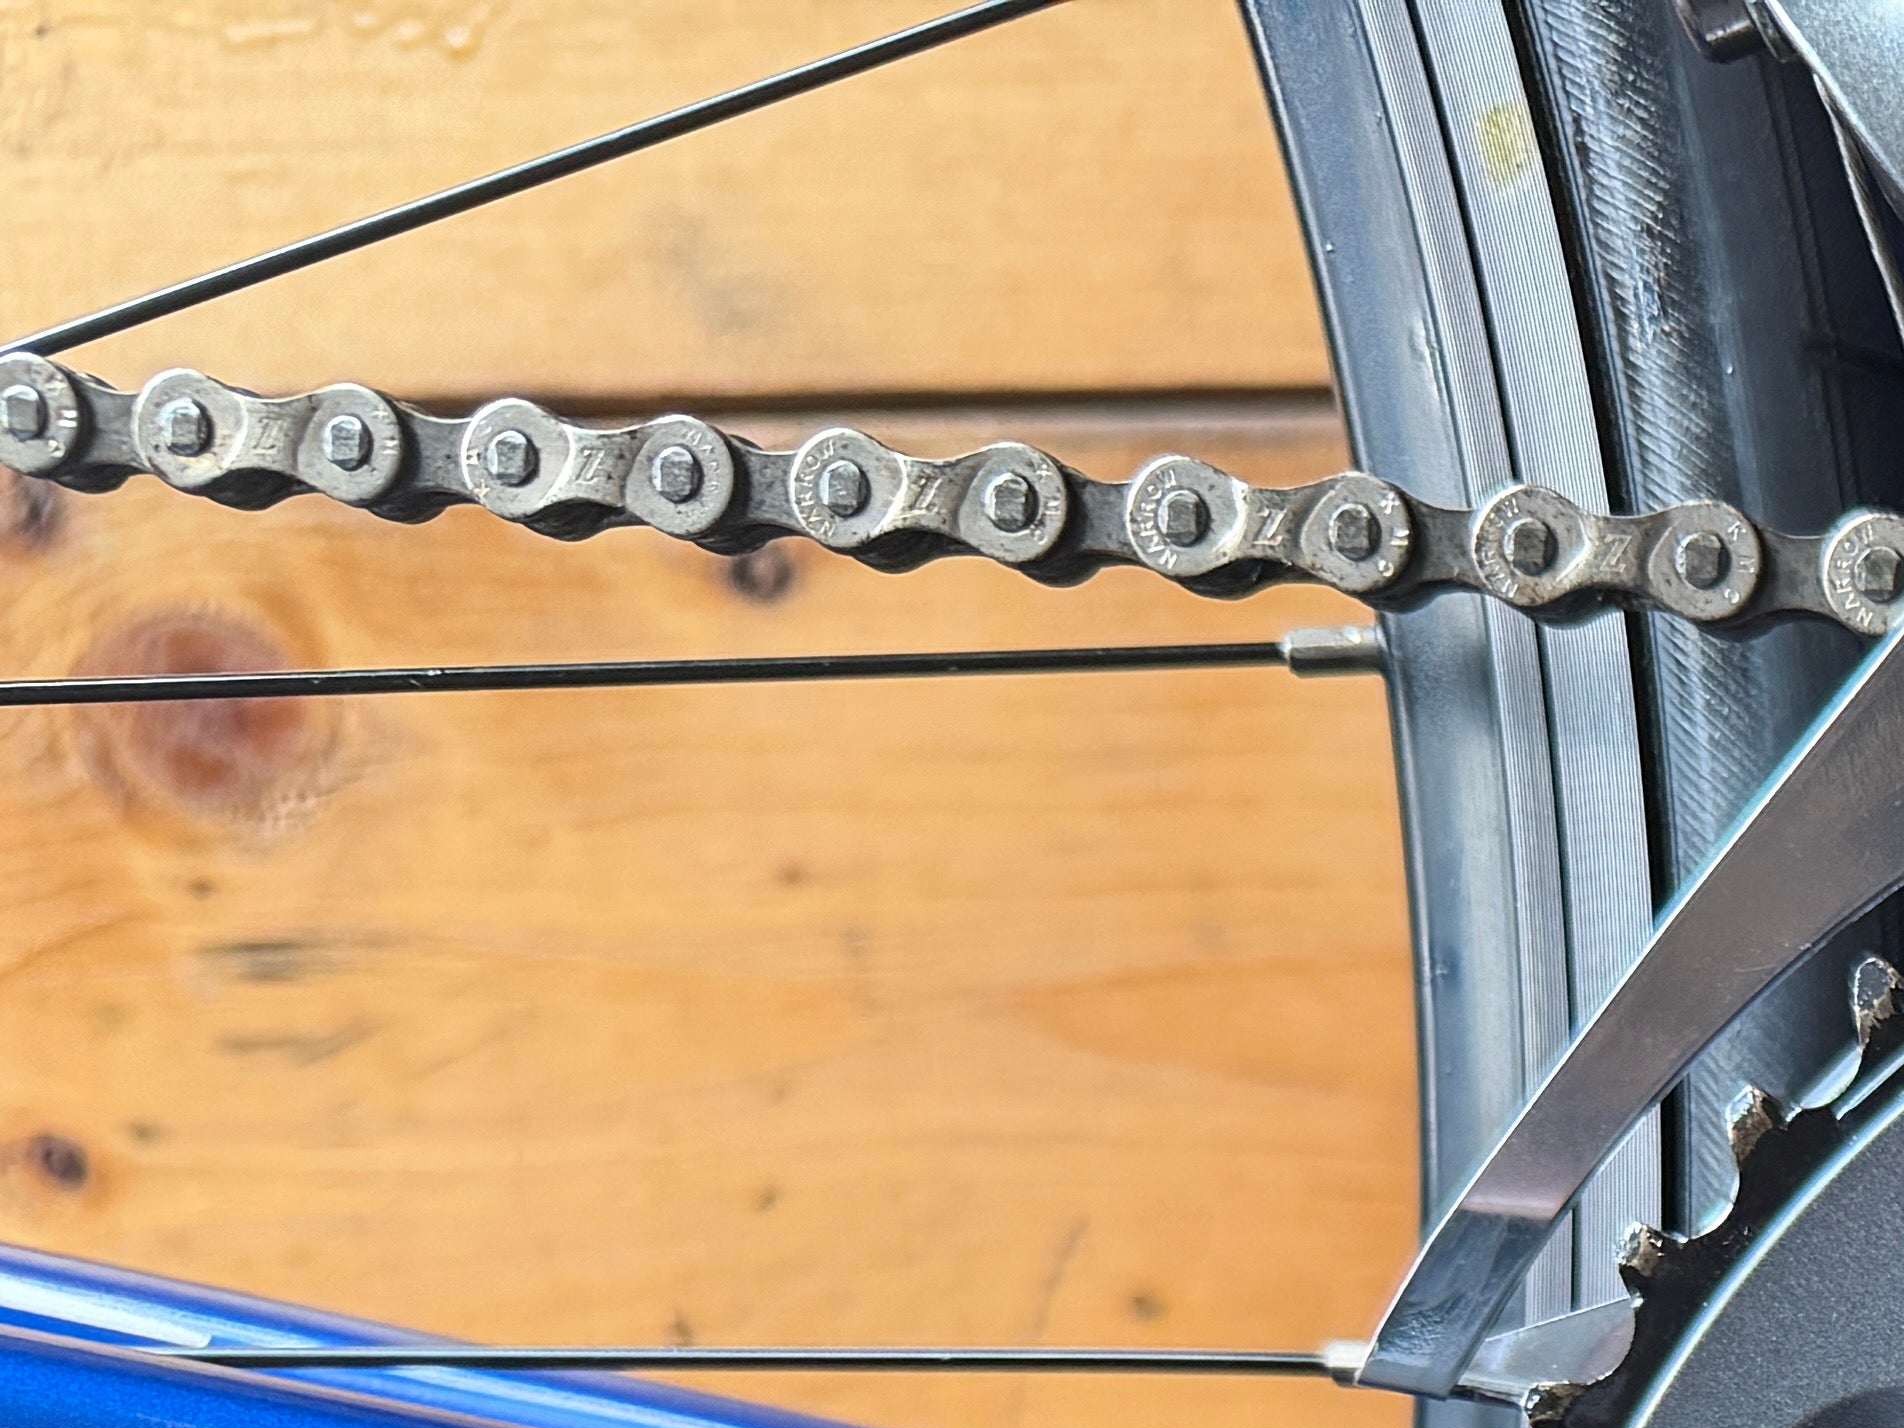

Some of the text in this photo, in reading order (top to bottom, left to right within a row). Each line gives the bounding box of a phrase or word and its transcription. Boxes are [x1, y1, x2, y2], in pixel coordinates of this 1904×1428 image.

[573, 448, 604, 486] Z
[1132, 466, 1178, 571] NARROW
[1252, 507, 1288, 547] Z
[1600, 533, 1634, 575] Z
[1722, 521, 1756, 604] KMC
[1833, 522, 1875, 628] NARROW
